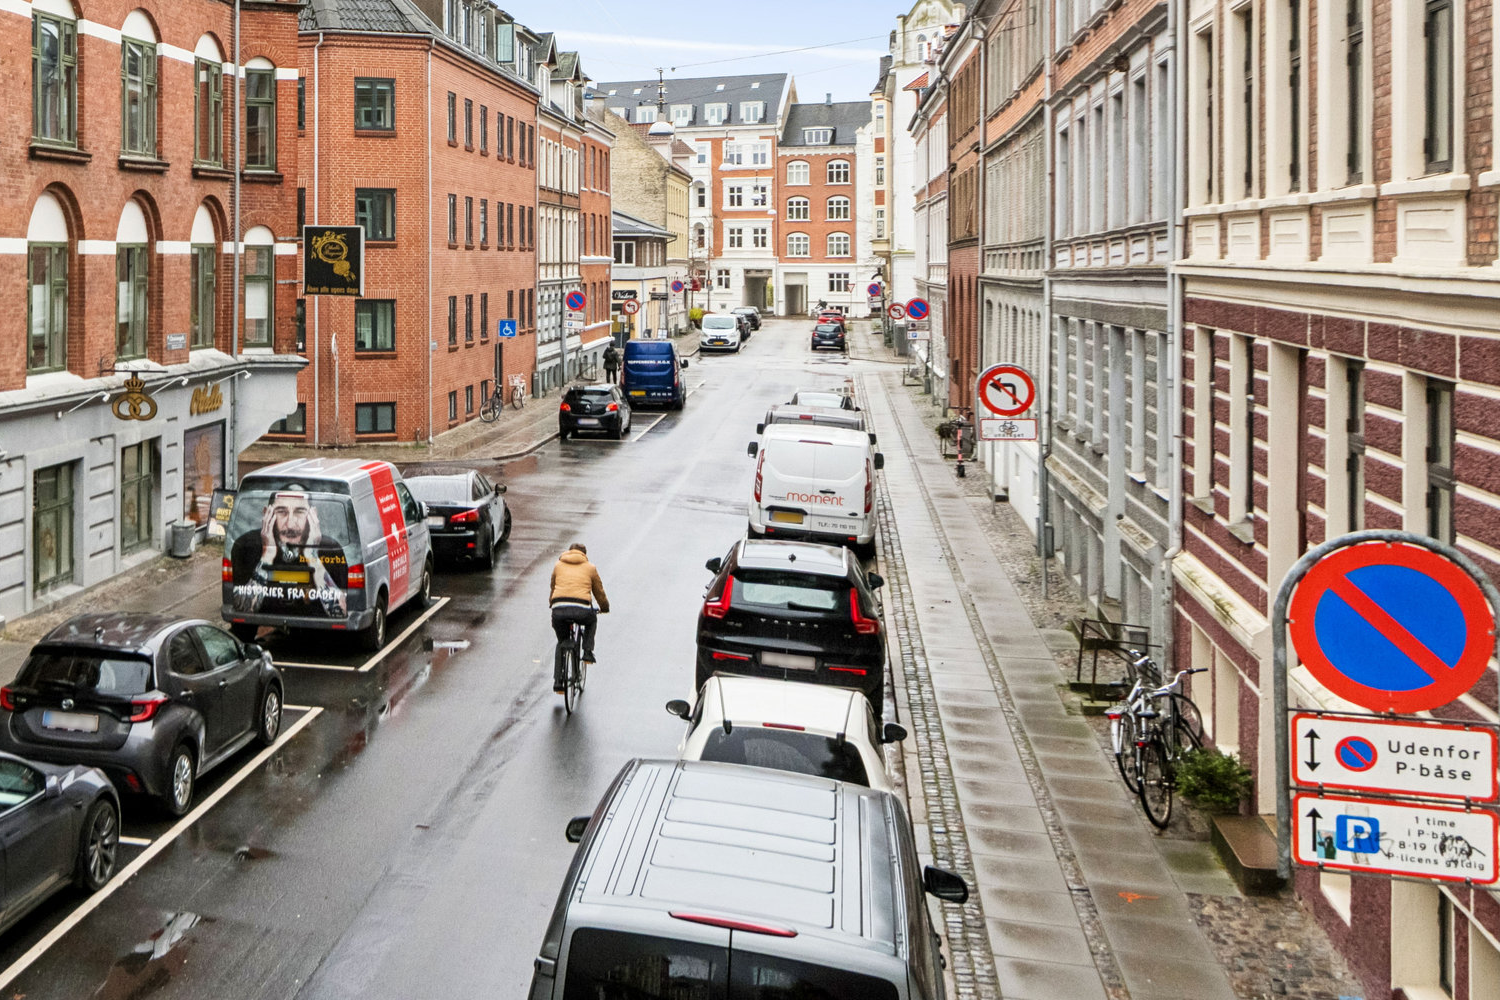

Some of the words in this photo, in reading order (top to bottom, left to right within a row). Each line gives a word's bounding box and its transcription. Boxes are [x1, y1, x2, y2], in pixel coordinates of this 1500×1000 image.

[786, 492, 844, 506] moment
[287, 587, 305, 599] FRA
[1387, 739, 1481, 760] Udenfor
[1396, 761, 1472, 781] P-båse
[1426, 817, 1456, 828] time
[1346, 818, 1372, 849] P
[1417, 829, 1462, 842] P-bås
